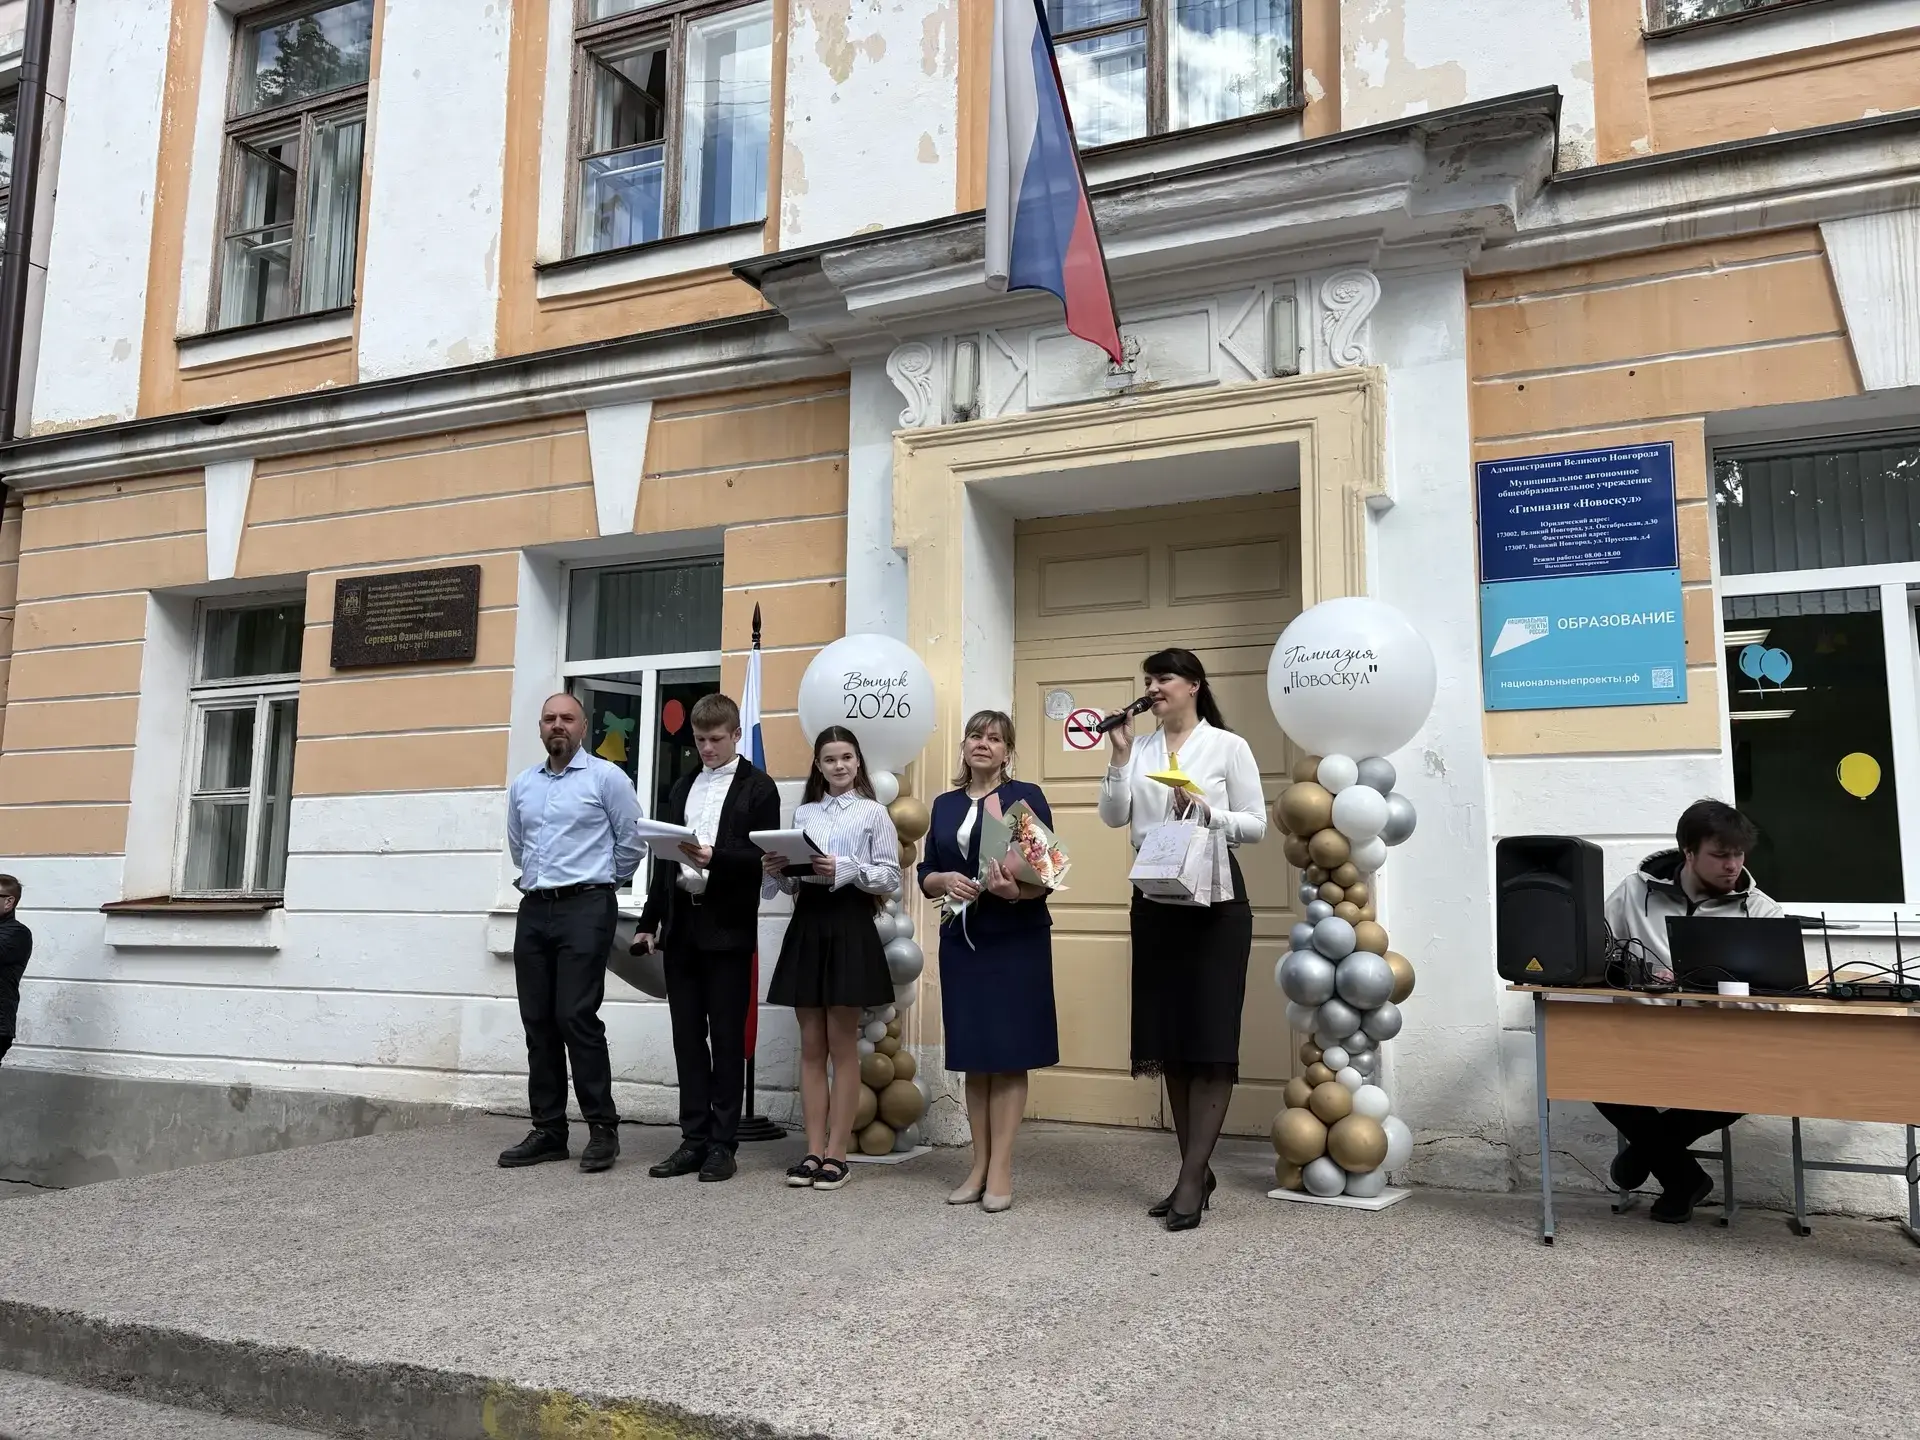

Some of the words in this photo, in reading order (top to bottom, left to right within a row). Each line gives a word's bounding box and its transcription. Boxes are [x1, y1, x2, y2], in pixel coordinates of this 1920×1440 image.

[1490, 460, 1562, 475] Администрация
[1564, 454, 1607, 467] Великого
[1609, 450, 1659, 463] Новгорода
[1497, 482, 1595, 498] общеобразовательное
[1596, 476, 1653, 490] учреждение
[1509, 473, 1583, 488] Муниципальное
[1585, 467, 1640, 479] автономное
[1509, 501, 1570, 515] «Гимназия
[1573, 495, 1642, 509] «Новоскул»
[1521, 528, 1549, 537] Великий
[1550, 525, 1582, 535] Новгород,
[1584, 524, 1595, 532] ул.
[1596, 520, 1643, 530] Октябрьская,
[1644, 518, 1659, 526] д.30
[1540, 517, 1588, 528] Юридический
[1590, 516, 1610, 524] адрес:
[1529, 541, 1557, 550] Великий
[1559, 539, 1591, 548] Новгород,
[1593, 537, 1604, 545] ул.
[1605, 535, 1639, 544] Прусская,
[1640, 533, 1651, 541] д.4
[1541, 532, 1587, 541] Фактический
[1589, 530, 1610, 539] адрес:
[1533, 554, 1556, 563] Режим
[1556, 553, 1584, 562] работы:
[1584, 550, 1621, 559] 08.00-18.00
[1557, 610, 1676, 630] ОБРАЗОВАНИЕ
[364, 634, 398, 646] Сергеева
[398, 631, 423, 642] Фаина
[424, 629, 462, 639] Ивановна
[1283, 645, 1378, 673] Гимназия
[843, 670, 909, 698] Выпуск
[1501, 673, 1640, 689] национальныепроекты.рф
[843, 693, 911, 720] 2026
